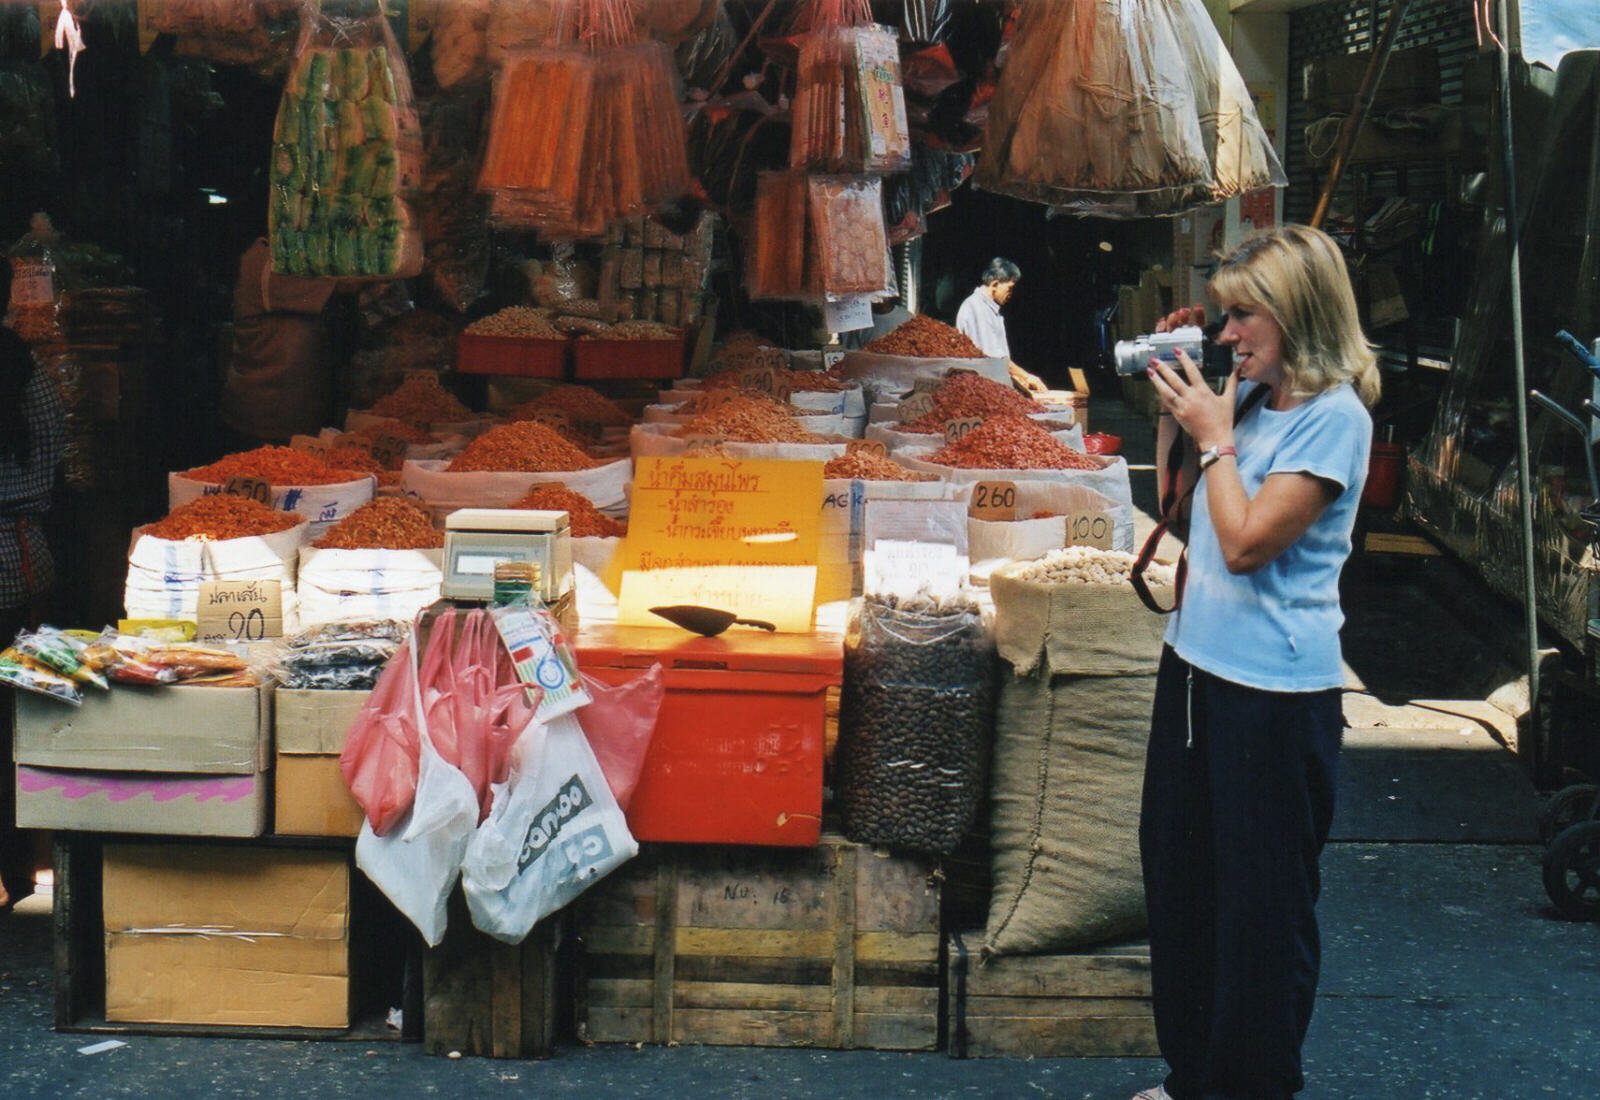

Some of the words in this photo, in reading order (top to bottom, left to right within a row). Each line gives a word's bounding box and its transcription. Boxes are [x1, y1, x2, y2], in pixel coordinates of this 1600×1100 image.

[976, 485, 1015, 508] 260
[1072, 516, 1107, 541] 100
[228, 607, 264, 641] 90
